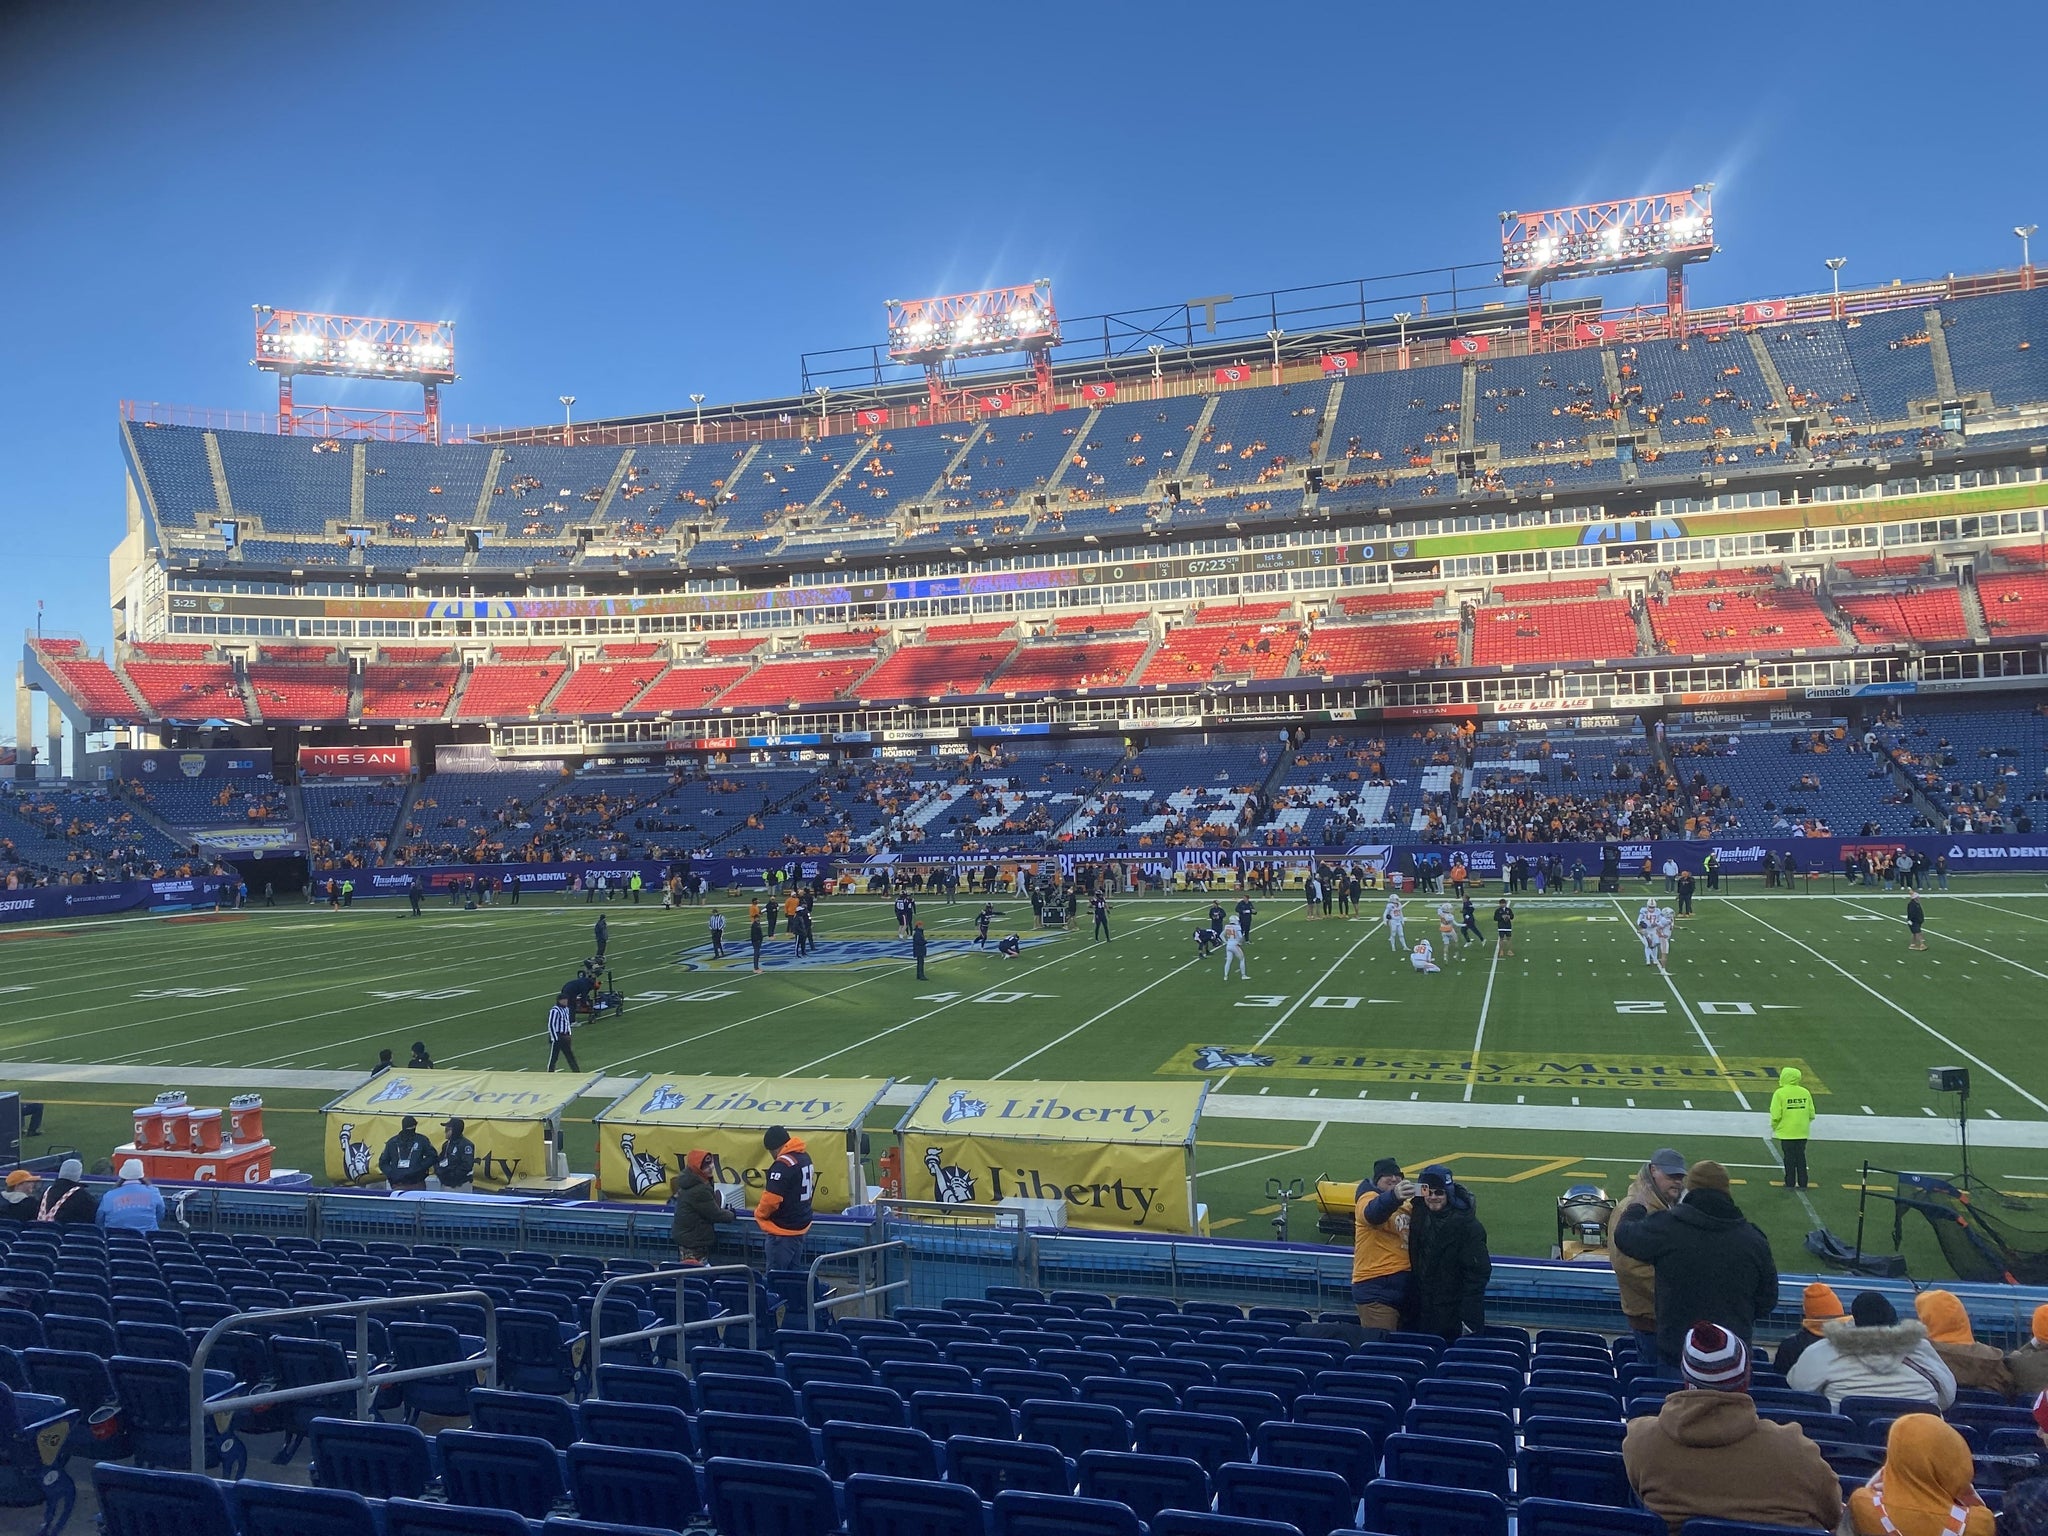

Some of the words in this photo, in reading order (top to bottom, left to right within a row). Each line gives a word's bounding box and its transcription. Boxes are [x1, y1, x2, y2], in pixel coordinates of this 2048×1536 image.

[1362, 546, 1375, 559] 0
[1188, 558, 1227, 574] 67:23
[1113, 567, 1124, 579] 0
[1161, 568, 1168, 577] 3
[173, 599, 197, 608] 3:25
[1698, 692, 1728, 703] Tito's
[1806, 687, 1850, 698] Pinnacle
[1694, 714, 1745, 723] CAMPBELL
[1770, 711, 1812, 720] PHILLIPS
[1581, 719, 1620, 728] BRAZILE
[800, 752, 830, 761] NOTON
[883, 750, 918, 758] HOUSTON
[939, 748, 970, 756] BLANDA
[314, 754, 397, 764] NISSAN
[623, 757, 651, 765] HONOR
[665, 759, 691, 767] ADAMS
[1470, 850, 1495, 859] Coca-Cola
[1967, 847, 2008, 858] DELTA
[1471, 858, 1496, 866] BOWL
[518, 873, 536, 882] ELTA
[536, 872, 567, 881] DENTAL
[1295, 1055, 1516, 1075] Liberty
[1537, 1062, 1781, 1079] Mutual
[1389, 1072, 1679, 1088] INSURANCE
[693, 1091, 845, 1121] Liberty
[996, 1098, 1169, 1133] Liberty
[231, 1116, 239, 1129] G
[134, 1122, 143, 1136] G
[163, 1122, 171, 1135] G
[190, 1124, 199, 1137] G
[244, 1163, 260, 1184] G
[987, 1165, 1159, 1227] Liberty
